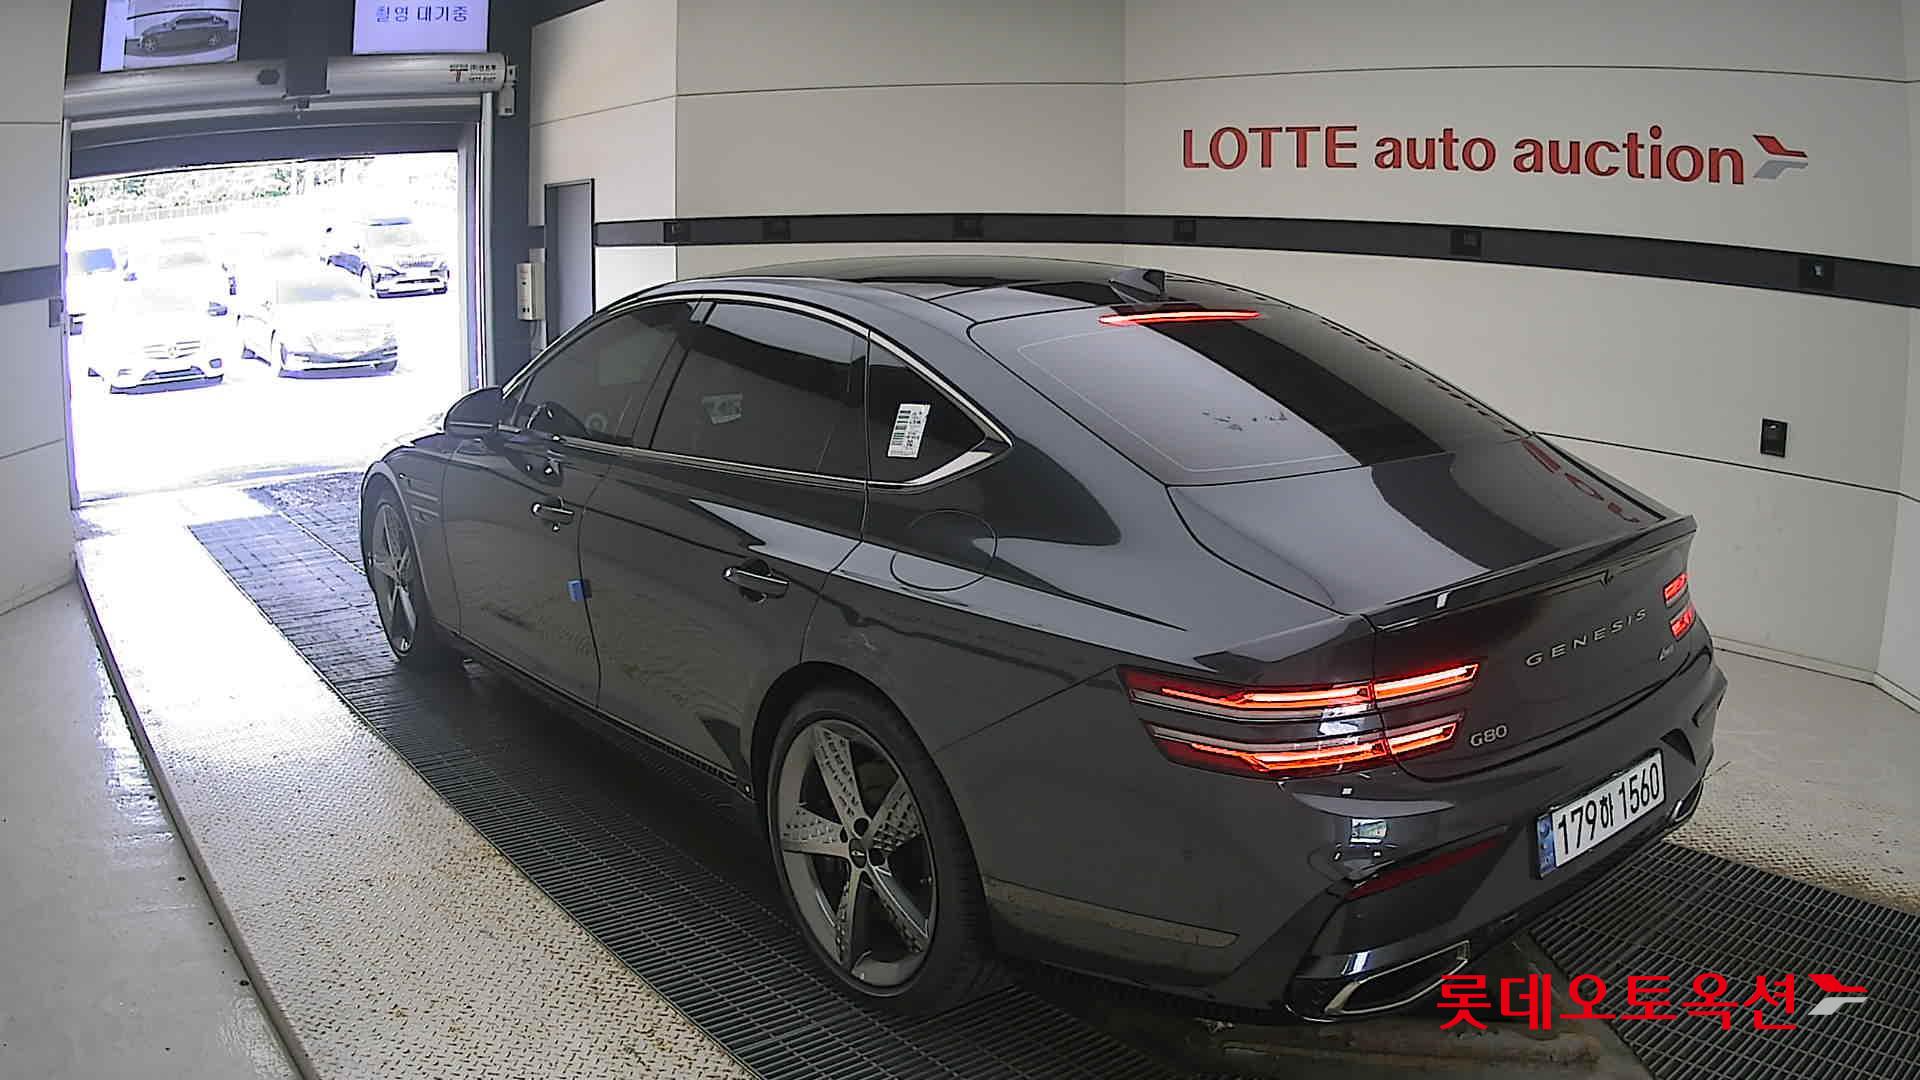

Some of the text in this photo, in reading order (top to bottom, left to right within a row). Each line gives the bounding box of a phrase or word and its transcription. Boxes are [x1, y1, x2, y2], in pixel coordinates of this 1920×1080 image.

[416, 5, 468, 22] 대기중
[1182, 124, 1744, 185] LOTTE auto auction
[1525, 608, 1648, 667] GENESIS
[1470, 724, 1508, 746] G80
[1558, 762, 1660, 854] 179하 1560
